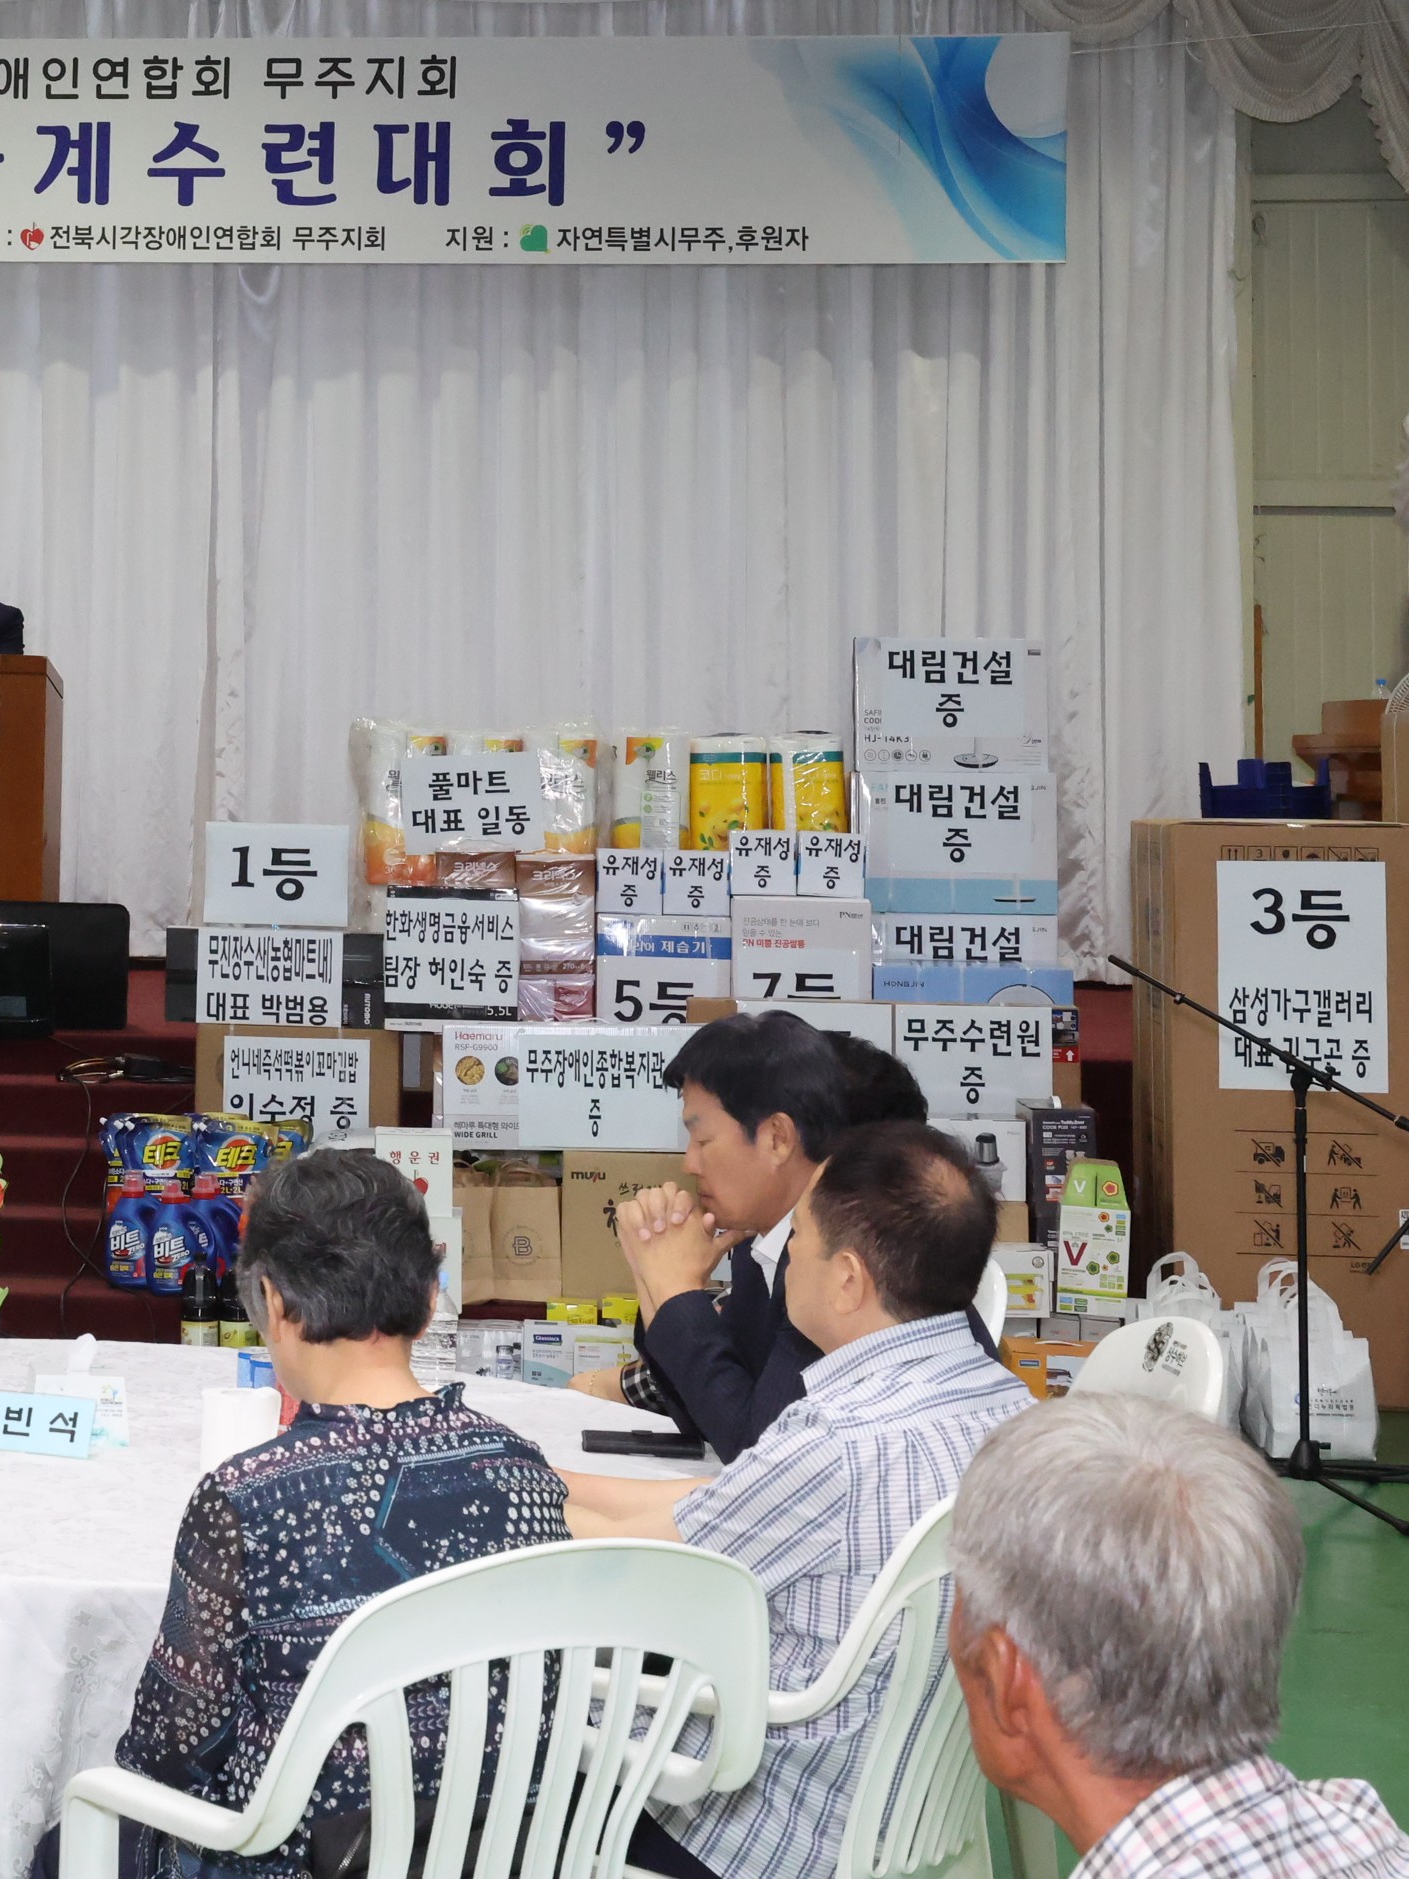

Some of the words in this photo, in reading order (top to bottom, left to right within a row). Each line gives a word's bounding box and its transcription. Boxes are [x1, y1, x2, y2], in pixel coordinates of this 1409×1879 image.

[264, 55, 456, 99] 무주지회
[50, 226, 280, 250] 전북시각장애인연합회
[293, 226, 384, 251] 무주지회
[446, 226, 492, 251] 지원
[557, 226, 808, 253] 자연특별시무주,후원자
[889, 650, 1012, 684] 대림건설
[936, 694, 964, 727] 증
[429, 771, 510, 801] 풀마트
[895, 784, 1020, 820] 대림건설
[412, 809, 464, 833] 대표
[478, 806, 530, 835] 일동
[736, 836, 789, 860] 유재성
[806, 836, 860, 862] 유재성
[943, 829, 971, 862] 증
[232, 846, 317, 901] 1등
[603, 855, 656, 880] 유재성
[669, 856, 723, 881] 유재성
[754, 866, 771, 888] 증
[823, 867, 840, 889] 증
[621, 885, 637, 907] 증
[688, 886, 704, 908] 증
[386, 910, 513, 944] 한화생명금융서비스
[1250, 888, 1350, 949] 3등
[209, 936, 332, 984] 무진장수산(농협마트내)
[660, 940, 706, 954] 제습기
[896, 926, 1022, 963] 대림건설
[385, 956, 420, 989] 팀장
[429, 957, 486, 991] 허인숙
[495, 961, 512, 993] 증
[207, 993, 249, 1021] 대표
[262, 994, 328, 1025] 박범용
[1229, 987, 1373, 1026] 삼성가구갤러리
[455, 1031, 503, 1041] Haemaru
[904, 1019, 1040, 1057] 무주수련원
[231, 1048, 358, 1083] 언니네즉석떡볶이꼬마김밥
[526, 1049, 665, 1090] 무주장애인종합복지관
[1351, 1038, 1371, 1079] 증
[961, 1067, 985, 1104] 증
[230, 1093, 316, 1123] 이수정
[330, 1096, 358, 1130] 증
[588, 1099, 602, 1138] 증
[454, 1131, 473, 1139] WIDE
[475, 1131, 498, 1139] GRILL
[142, 1140, 182, 1166] 테크
[215, 1143, 258, 1169] 테크
[110, 1229, 141, 1251] 비트
[154, 1236, 186, 1258] 비트
[171, 1249, 190, 1263] ZERO
